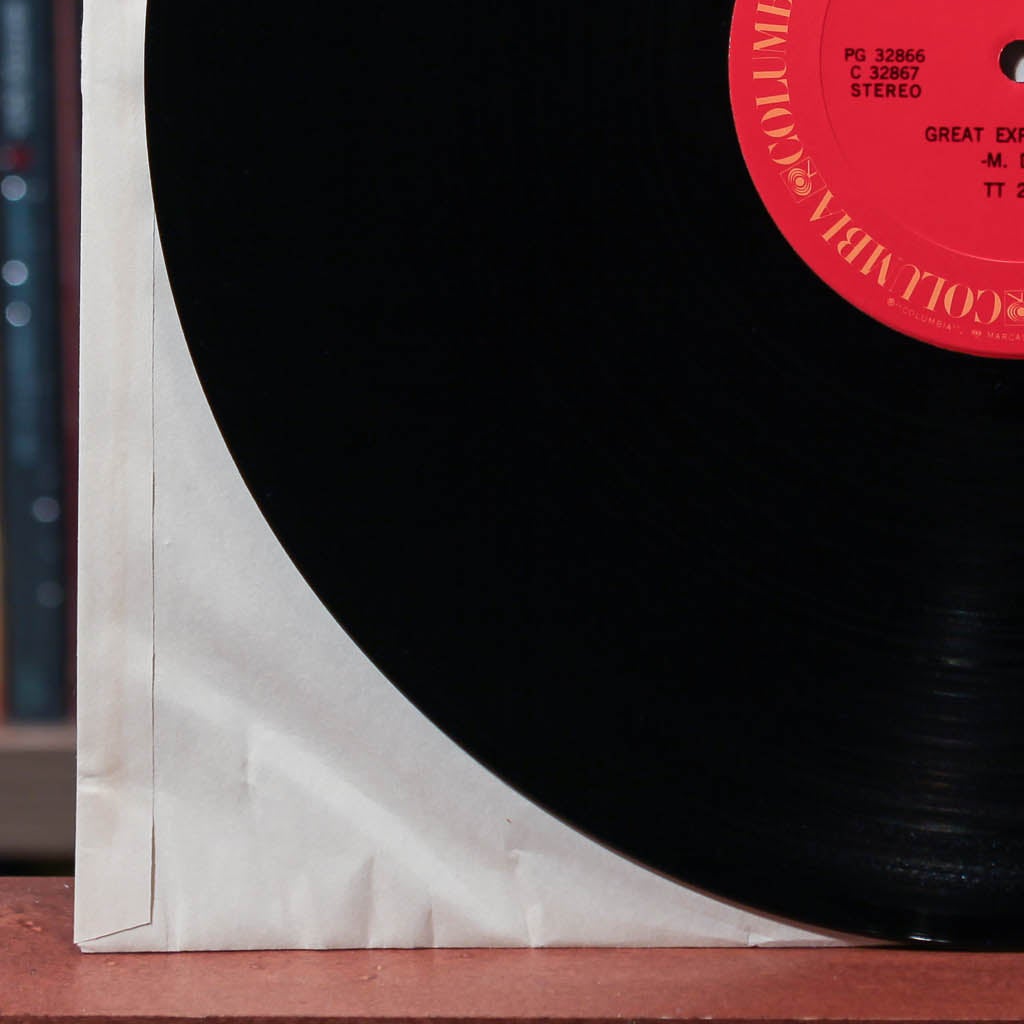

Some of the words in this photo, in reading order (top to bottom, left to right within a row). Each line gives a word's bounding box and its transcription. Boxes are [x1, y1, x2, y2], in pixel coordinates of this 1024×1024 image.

[844, 48, 866, 62] PG
[875, 48, 926, 63] 32866
[850, 65, 861, 79] C
[869, 65, 920, 80] 32867
[851, 82, 922, 99] STEREO
[925, 126, 984, 143] GREAT
[984, 182, 1006, 198] TT
[809, 190, 1001, 325] COLUMBIA
